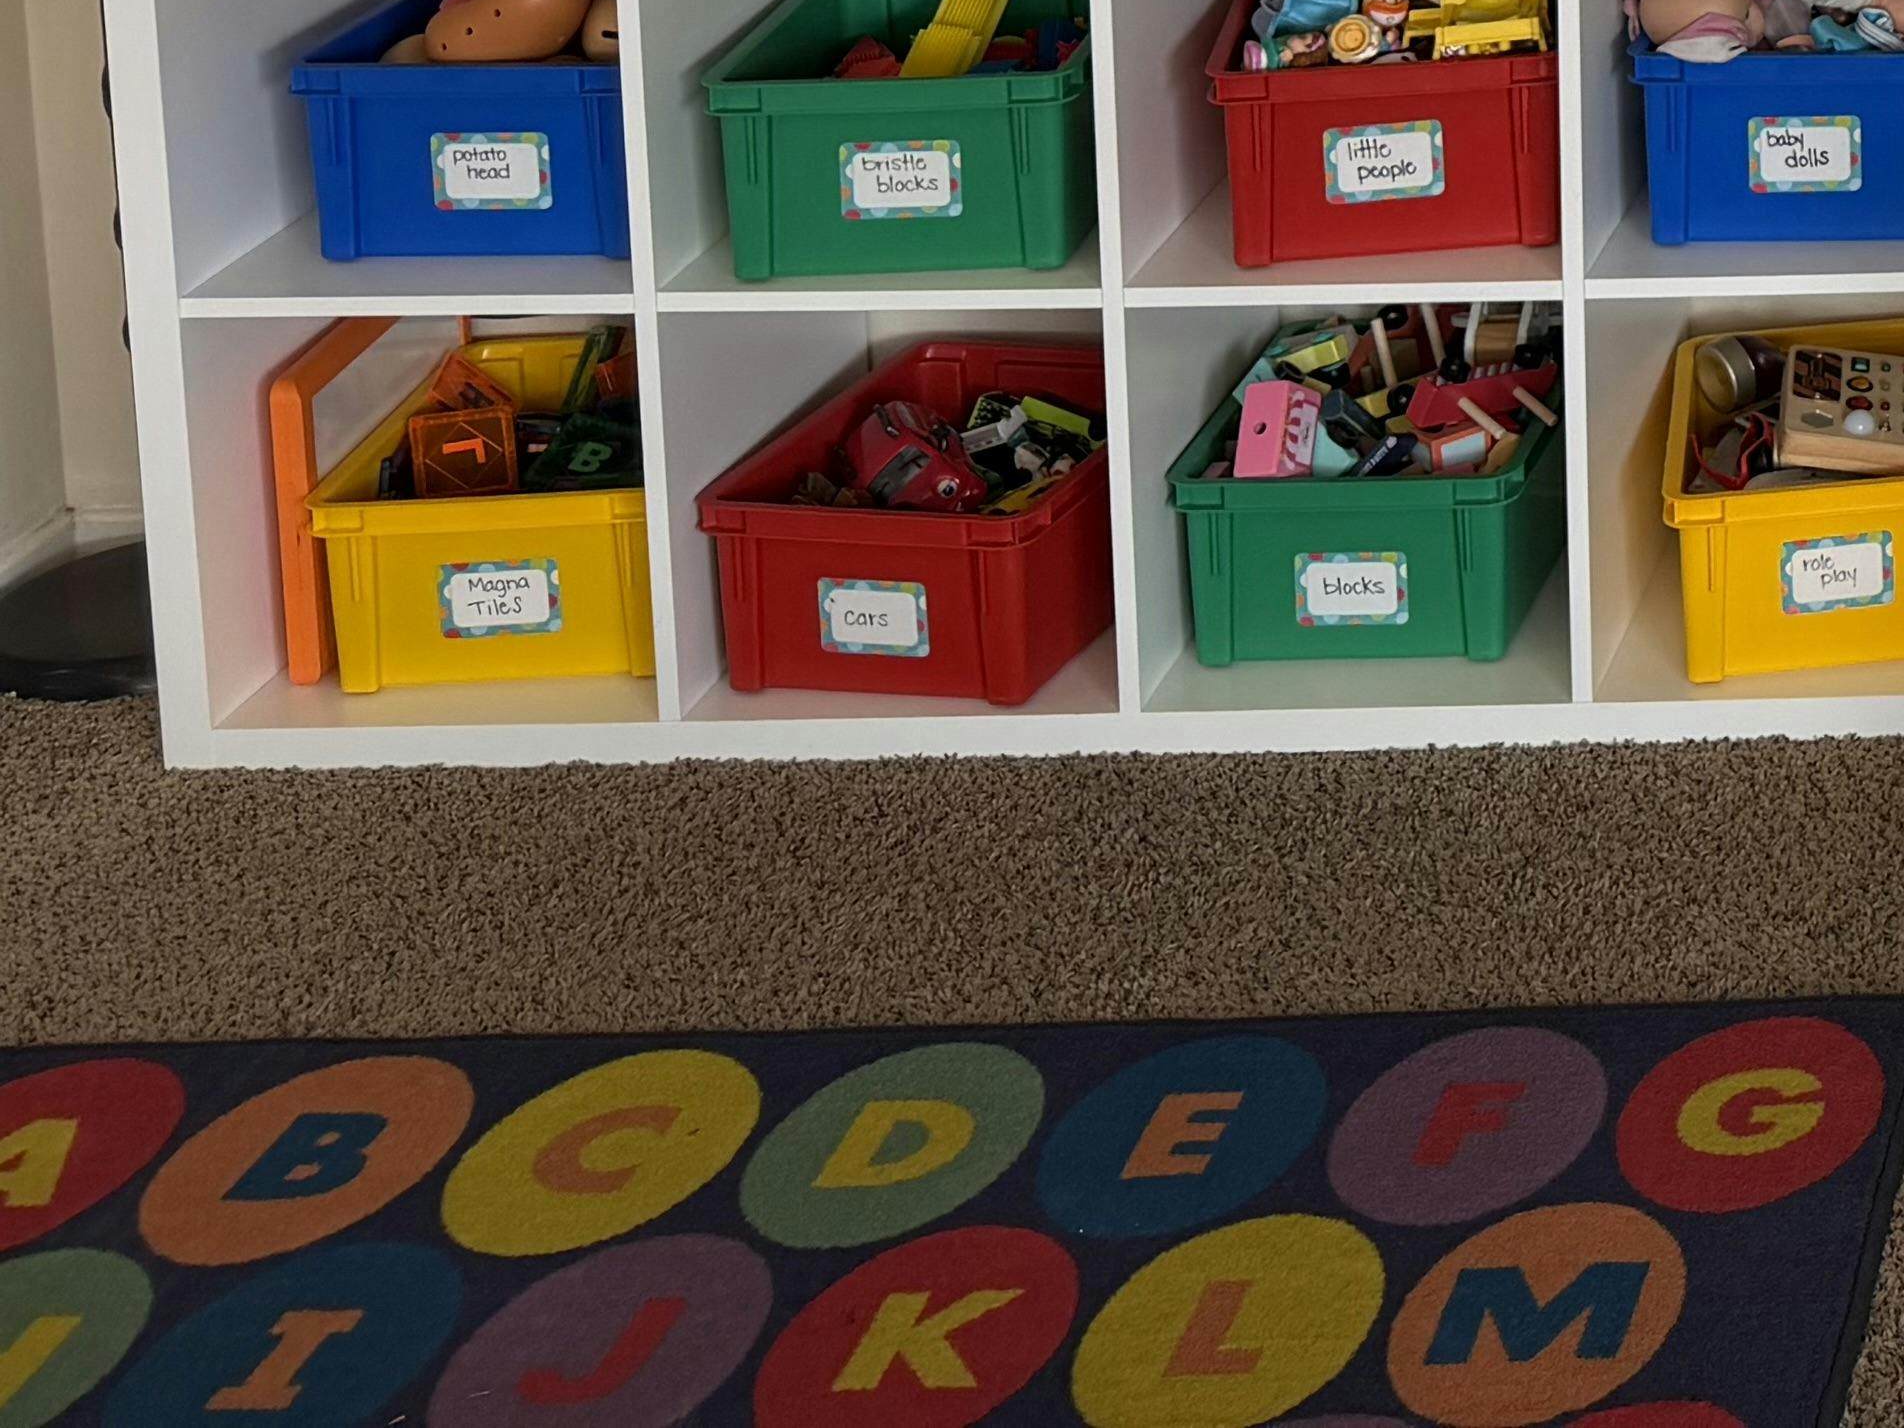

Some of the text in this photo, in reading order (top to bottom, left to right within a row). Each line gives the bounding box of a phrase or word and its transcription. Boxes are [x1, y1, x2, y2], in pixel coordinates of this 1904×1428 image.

[1346, 138, 1392, 160] little
[1765, 129, 1805, 153] baby
[452, 147, 507, 167] potato
[860, 155, 927, 174] bristle
[1784, 147, 1829, 168] dolls
[466, 164, 510, 182] head
[1356, 158, 1418, 184] people
[876, 174, 939, 194] blocks
[1802, 553, 1835, 572] role
[467, 575, 530, 599] Magna
[1322, 575, 1386, 599] blocks
[1819, 564, 1858, 589] play
[221, 1113, 389, 1202] B
[533, 1105, 686, 1196] C
[810, 1100, 975, 1188] D
[1119, 1091, 1245, 1180] E
[1412, 1082, 1527, 1165] F
[1677, 1067, 1824, 1156] G
[205, 1262, 1651, 1410] I J K L M
